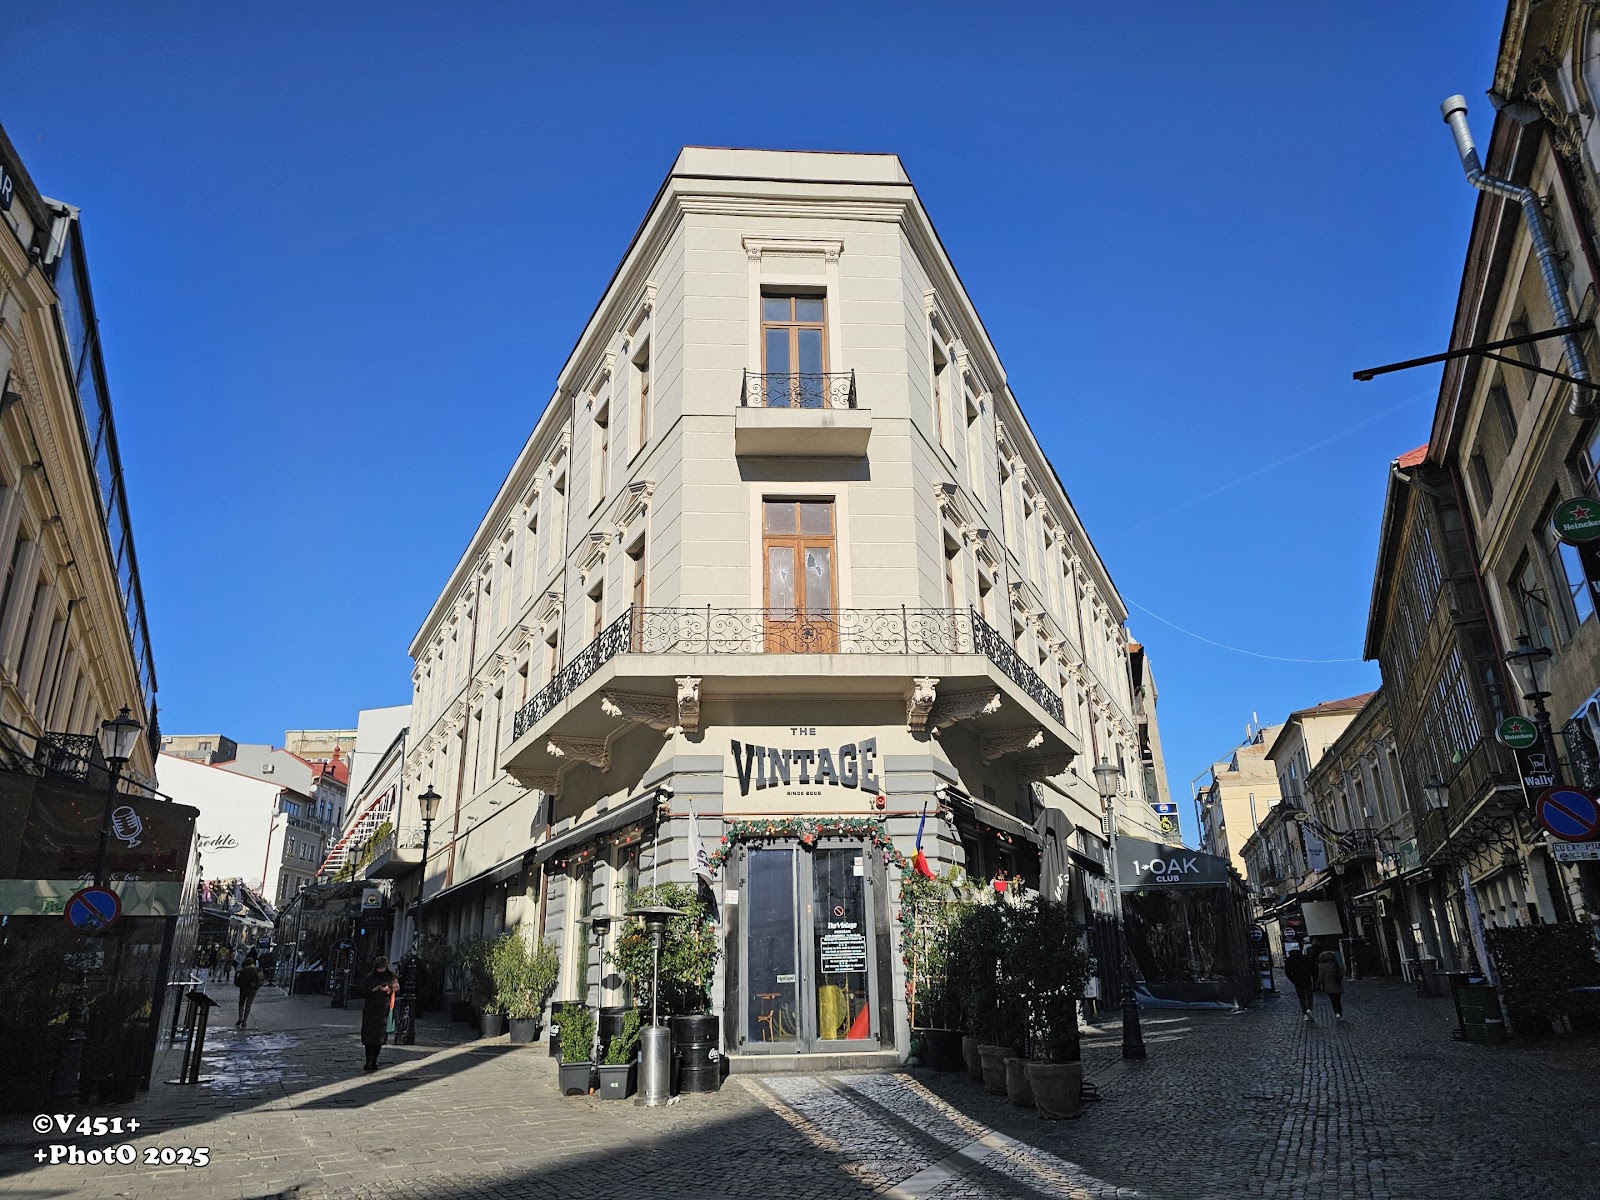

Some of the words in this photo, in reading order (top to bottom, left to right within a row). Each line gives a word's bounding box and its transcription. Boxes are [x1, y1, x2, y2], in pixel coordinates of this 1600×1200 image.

[0, 165, 12, 202] R
[1563, 519, 1600, 531] Heineke
[790, 727, 816, 736] THE
[731, 736, 879, 797] VINTAGE
[78, 872, 95, 880] clu
